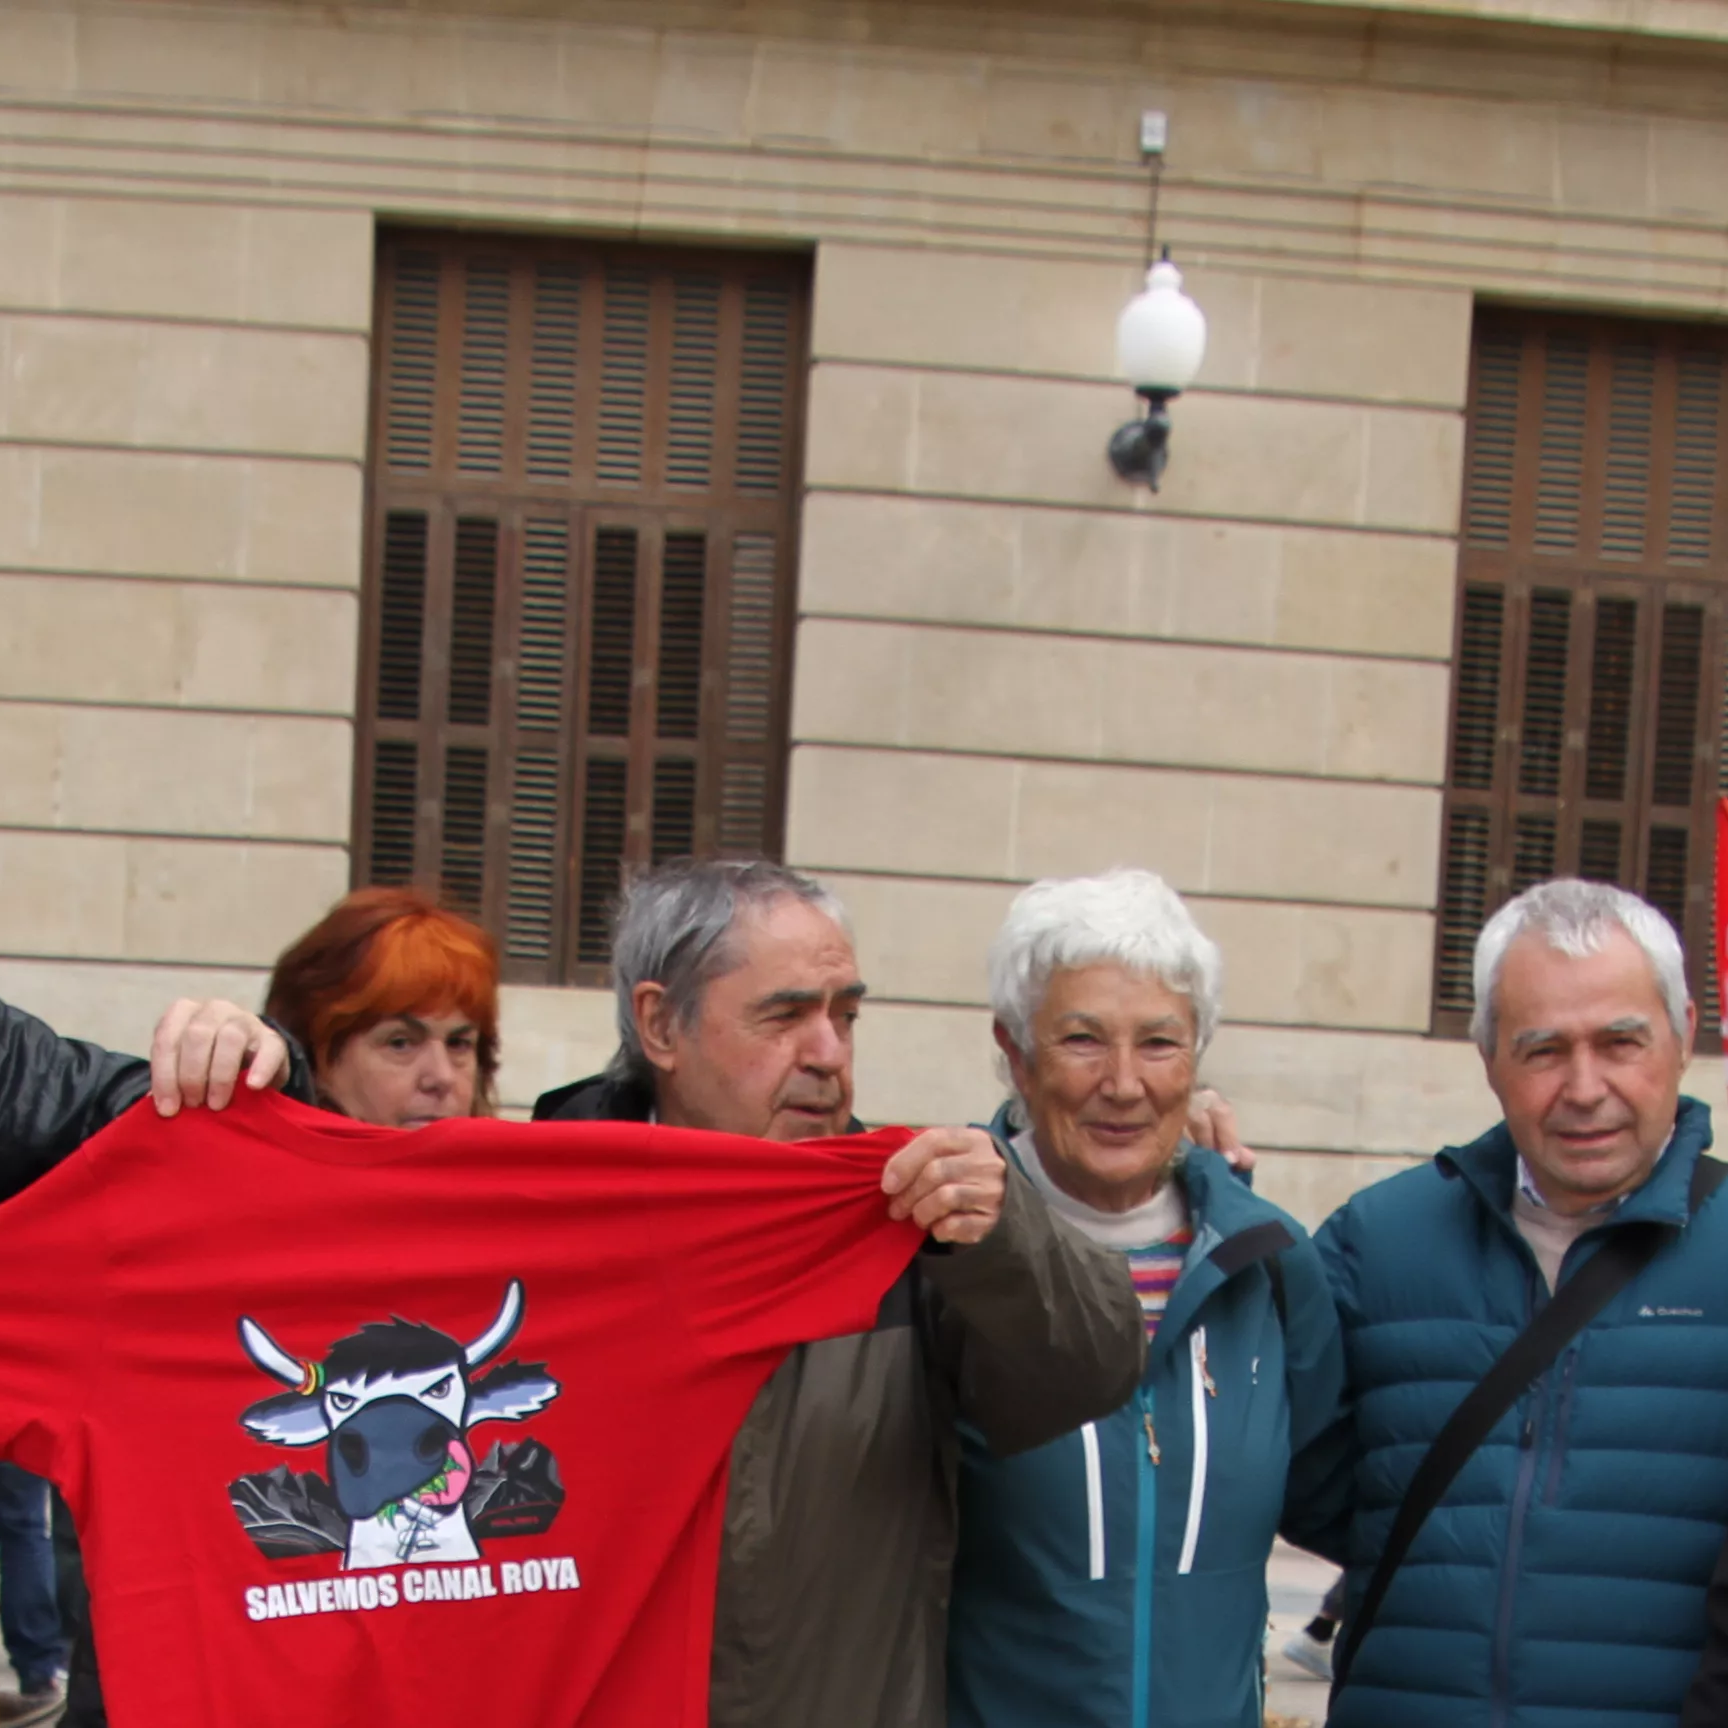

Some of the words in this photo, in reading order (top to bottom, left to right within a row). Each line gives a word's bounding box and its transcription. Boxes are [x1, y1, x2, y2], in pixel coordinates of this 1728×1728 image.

[245, 1573, 397, 1621] SALVEMOS
[403, 1566, 497, 1602] CANAL
[501, 1556, 580, 1594] ROYA
